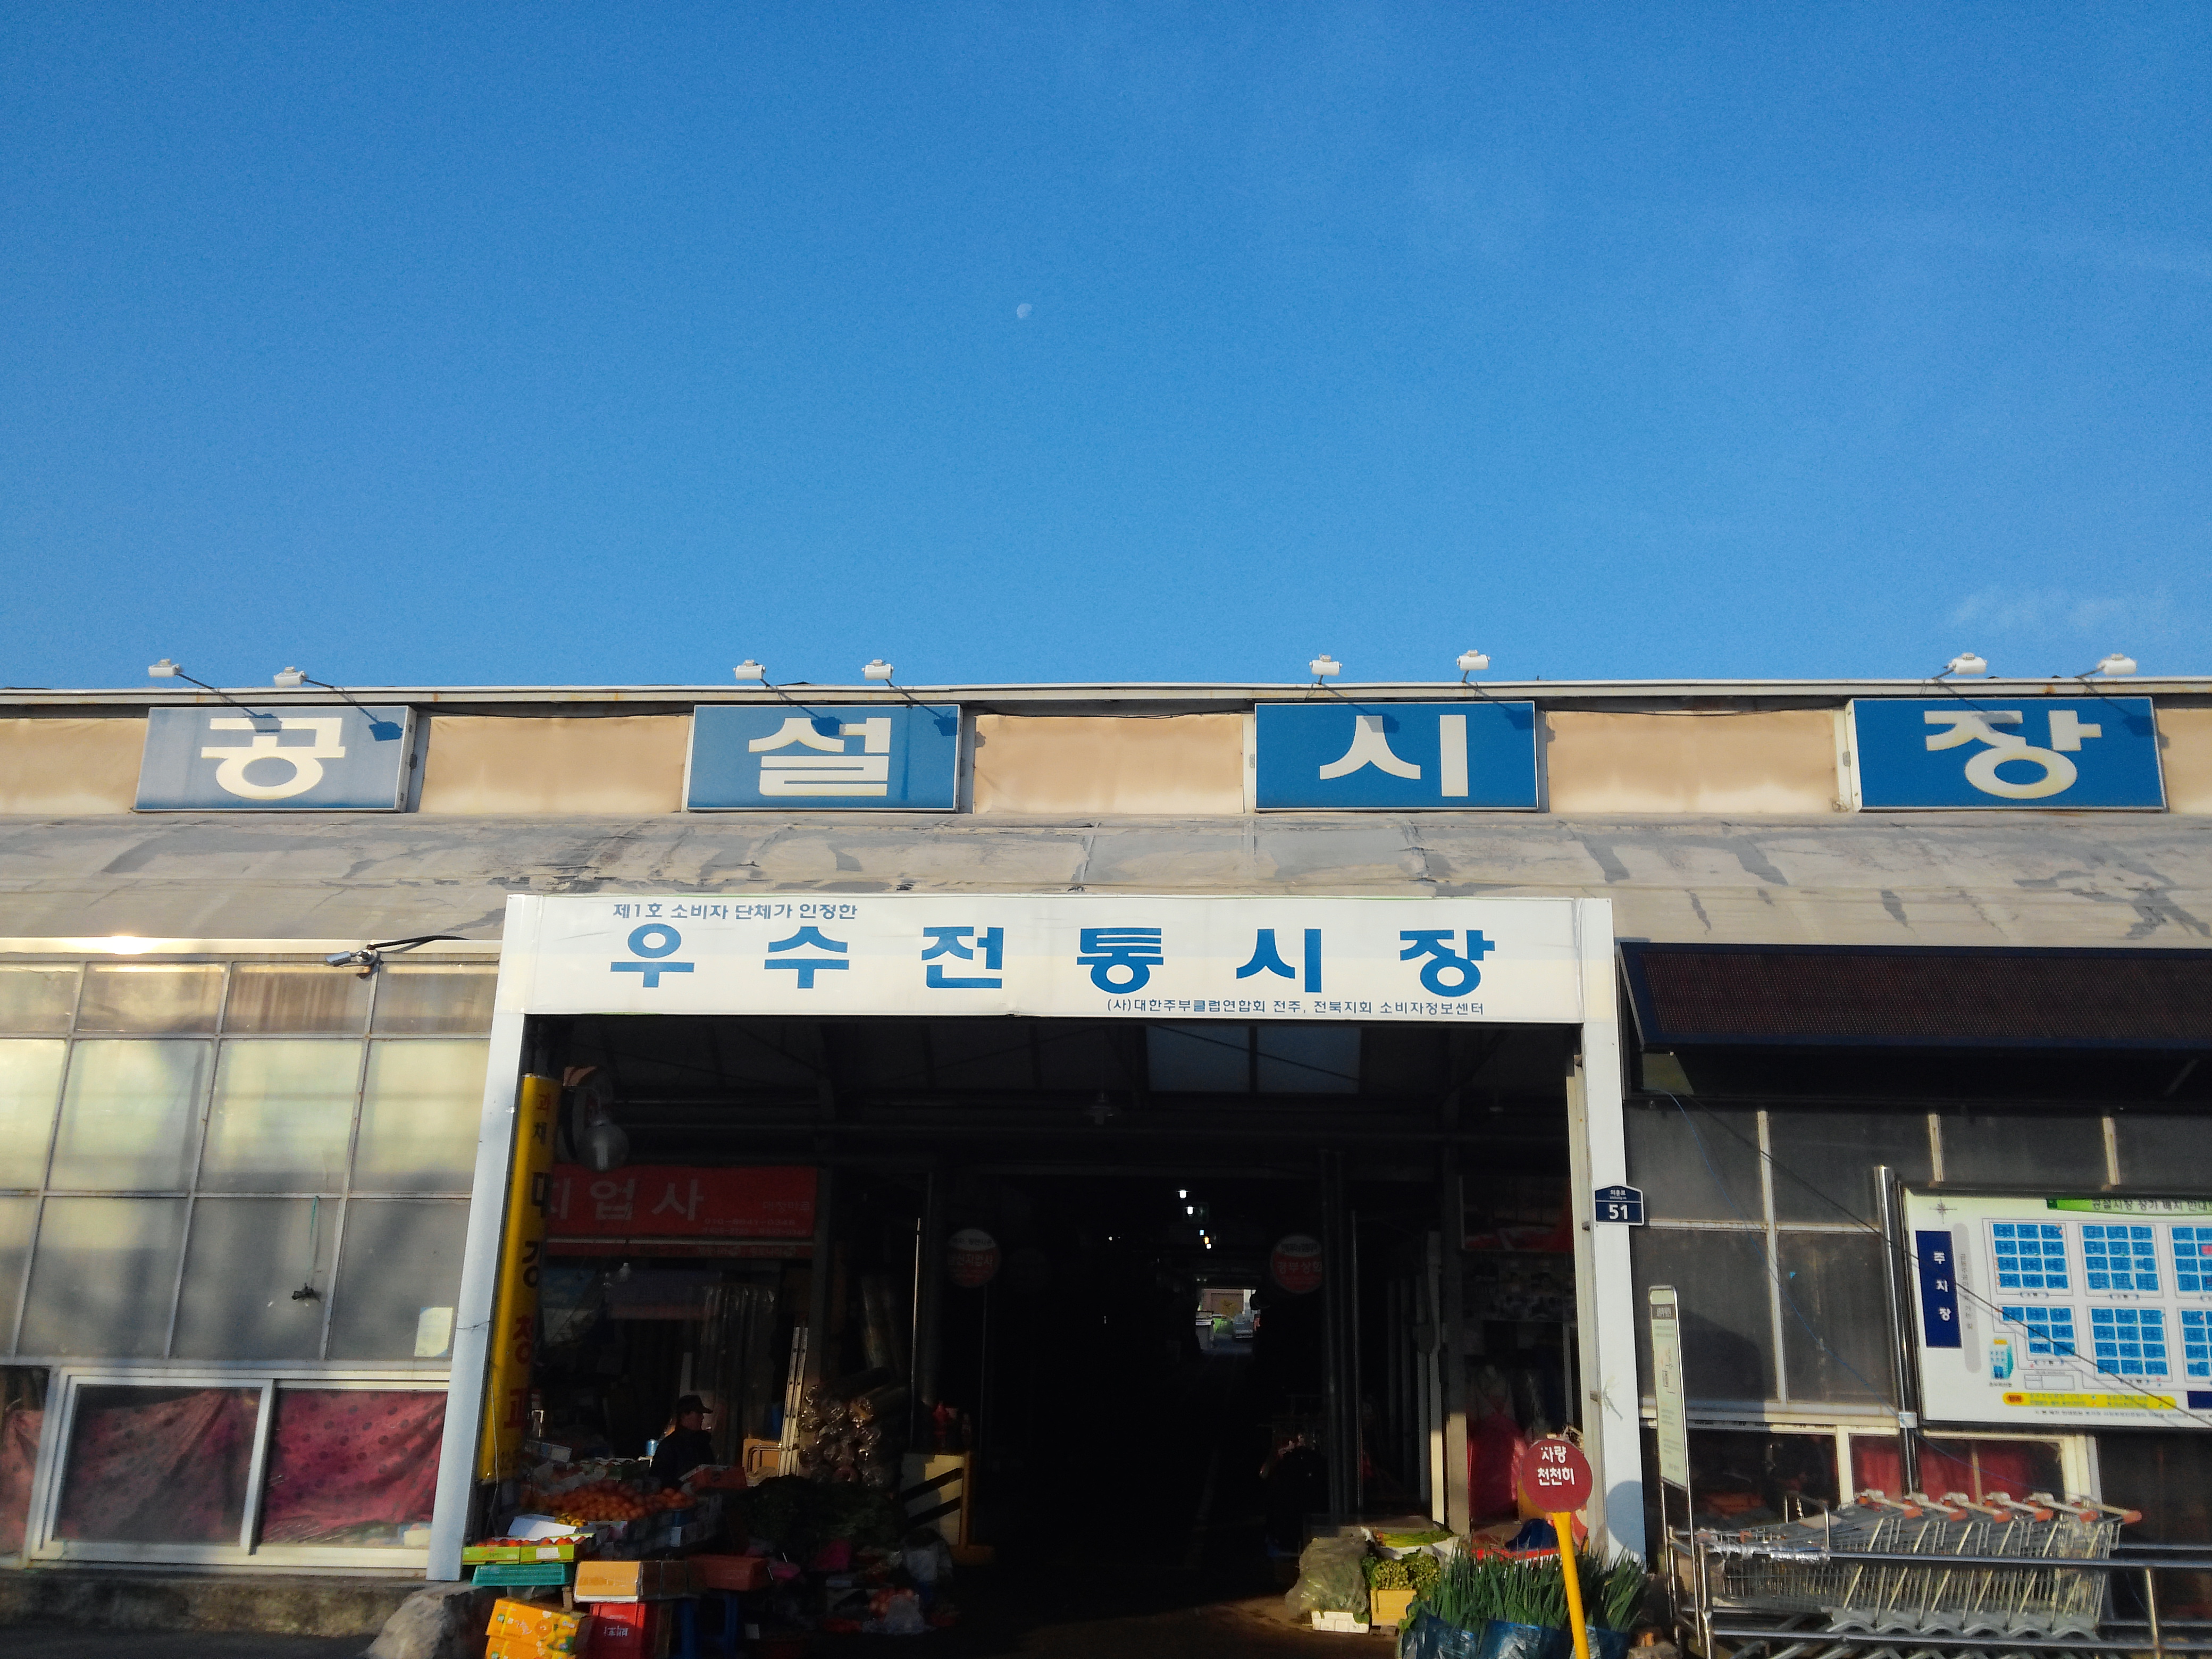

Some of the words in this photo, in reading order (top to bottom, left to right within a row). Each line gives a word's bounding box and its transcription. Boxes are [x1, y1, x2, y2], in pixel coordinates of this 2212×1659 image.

[200, 717, 346, 800] 공
[747, 716, 891, 798] 설
[1319, 714, 1470, 799] 시
[1925, 710, 2103, 800] 장
[612, 902, 663, 919] 제1호
[670, 903, 728, 920] 소비자
[735, 903, 792, 920] 단체가
[799, 903, 858, 920] 인정한
[1108, 999, 1266, 1012] (사)대한주부클럽연합회
[1273, 1000, 1306, 1014] 전주,
[1314, 1000, 1372, 1014] 전북지회
[1379, 1002, 1485, 1016] 소비자정보센터
[1609, 1204, 1628, 1220] 51
[1540, 1445, 1567, 1464] 차량
[1537, 1468, 1575, 1486] 천천히
